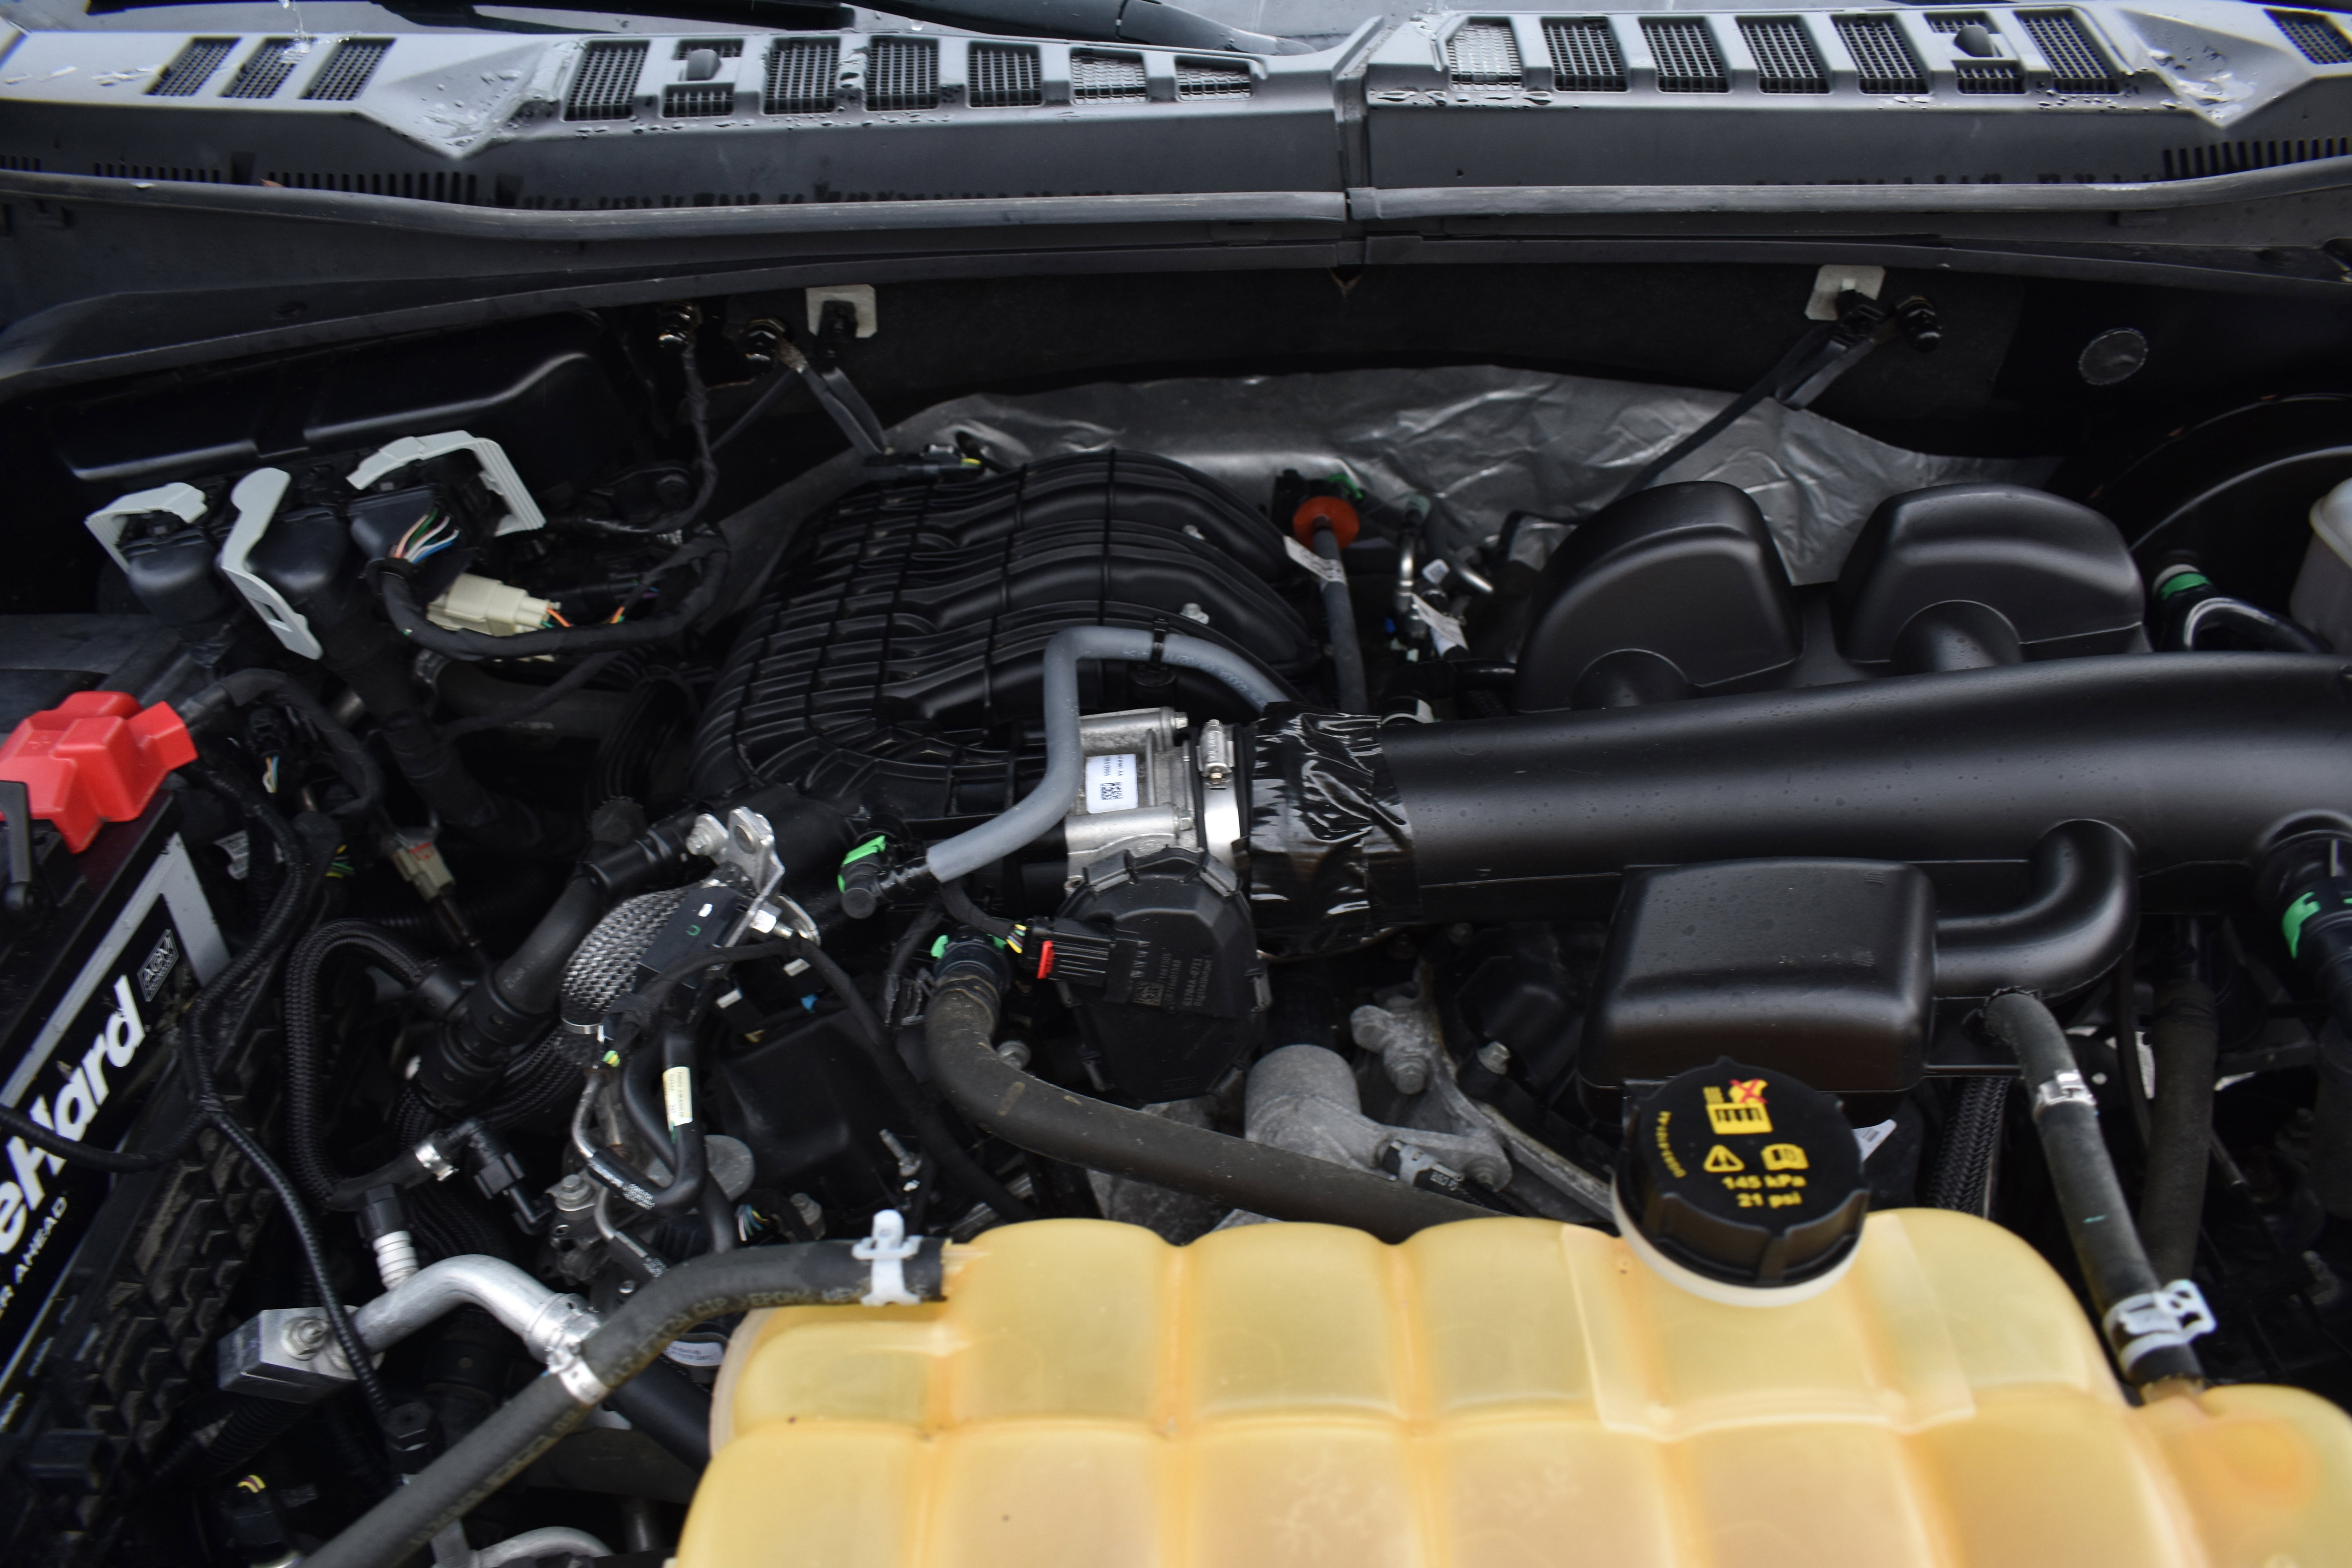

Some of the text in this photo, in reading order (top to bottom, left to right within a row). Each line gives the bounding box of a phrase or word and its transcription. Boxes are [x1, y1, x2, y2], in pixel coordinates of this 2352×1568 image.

[1721, 1175, 1762, 1190] 145
[1736, 1190, 1803, 1209] 21 psi
[12, 1196, 68, 1285] AHEAD
